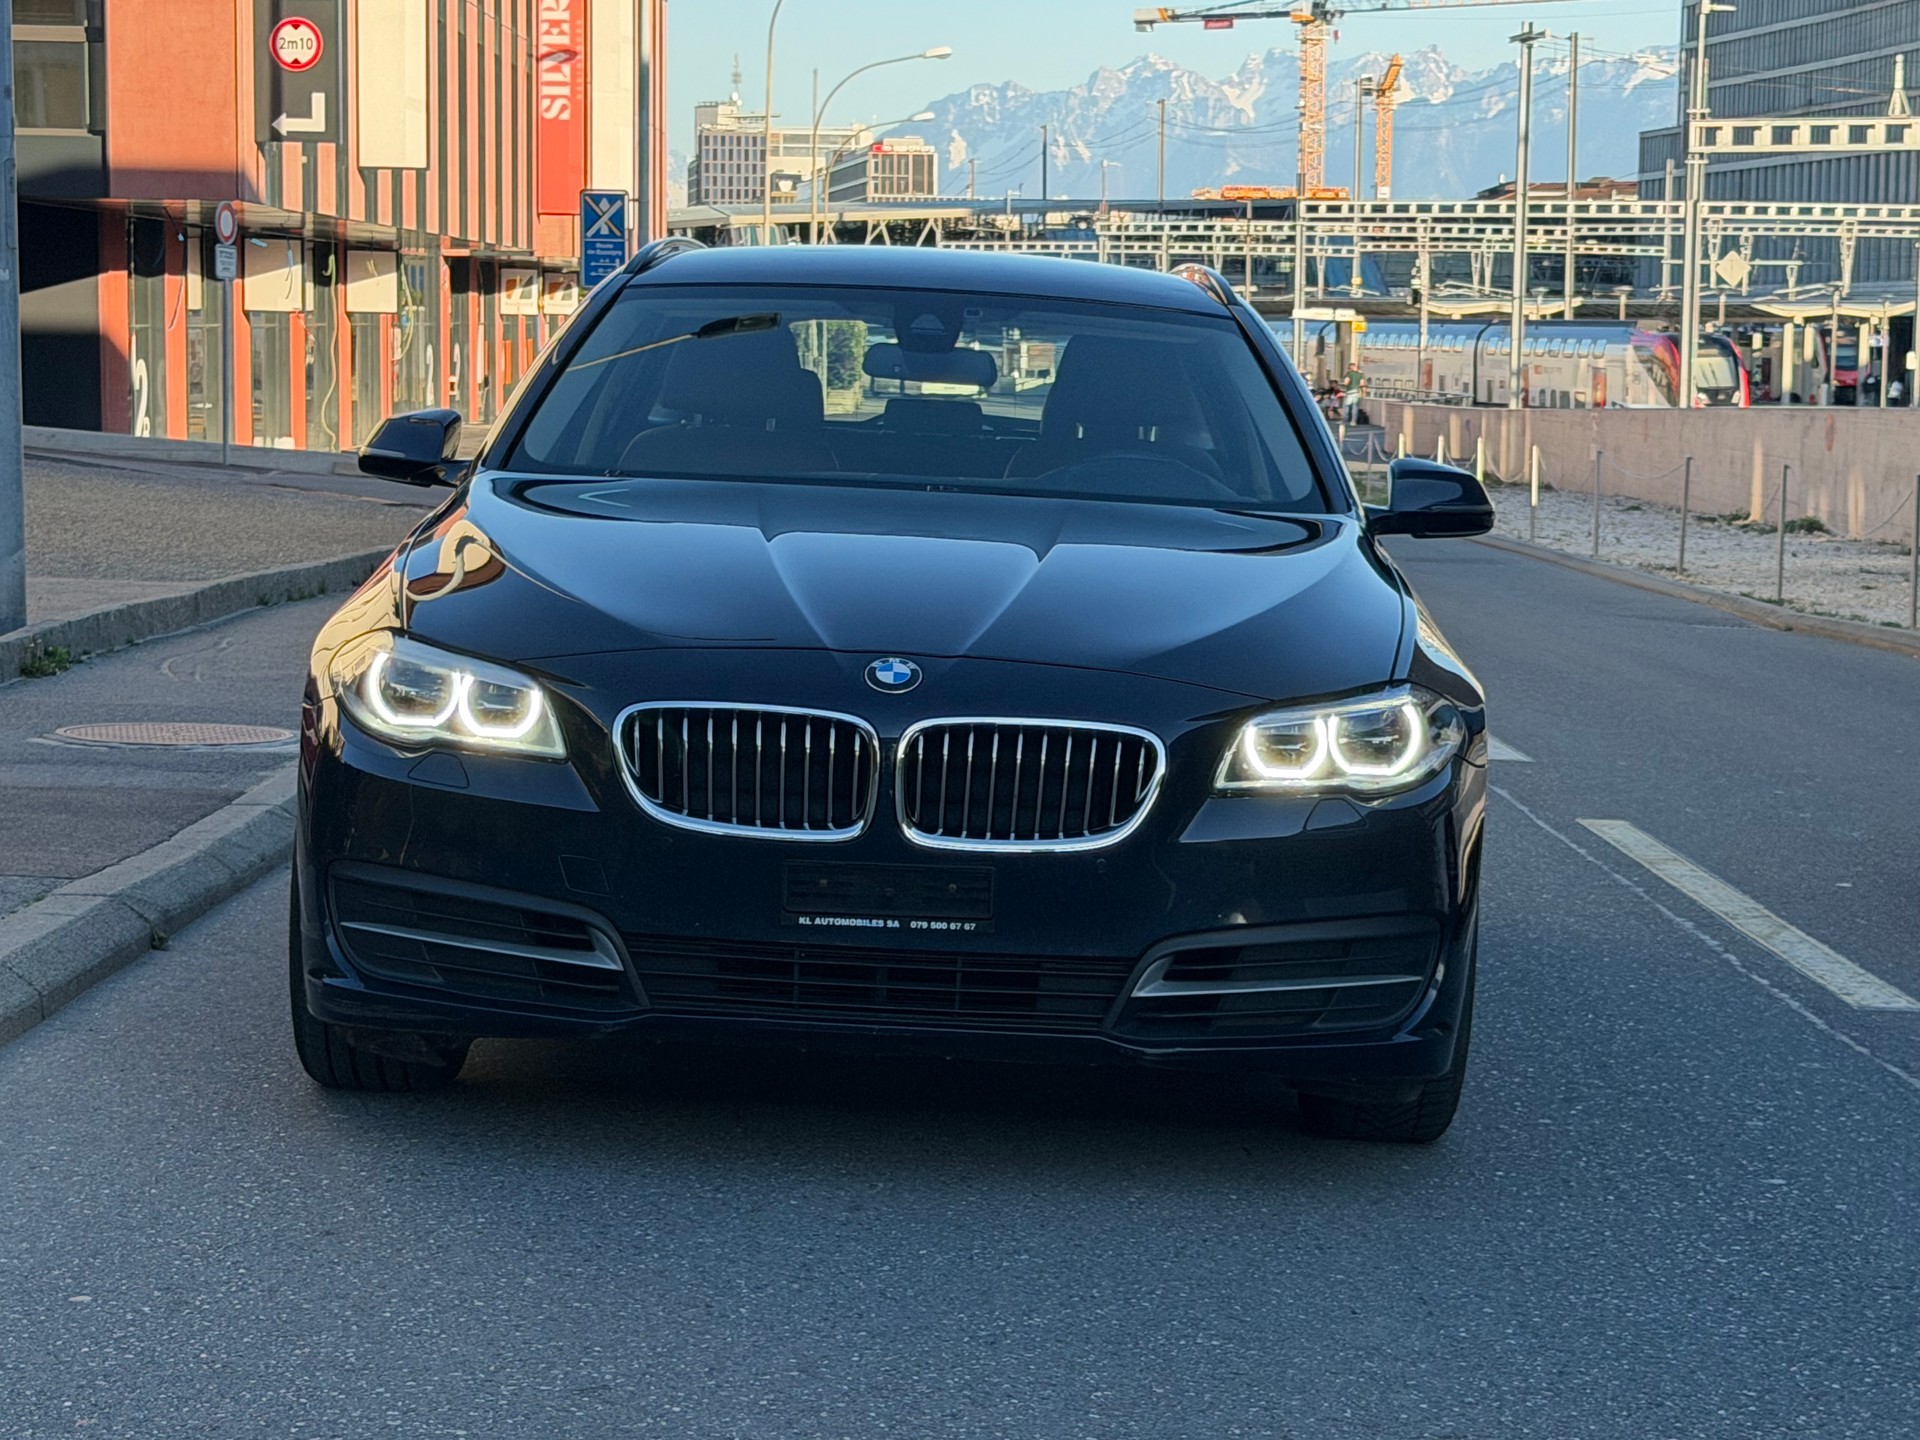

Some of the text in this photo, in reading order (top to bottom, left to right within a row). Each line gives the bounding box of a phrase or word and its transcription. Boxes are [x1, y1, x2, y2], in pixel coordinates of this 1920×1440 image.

[279, 37, 313, 50] 2m10
[798, 916, 900, 928] KL AUTOMOBILES SA
[910, 921, 928, 930] 079
